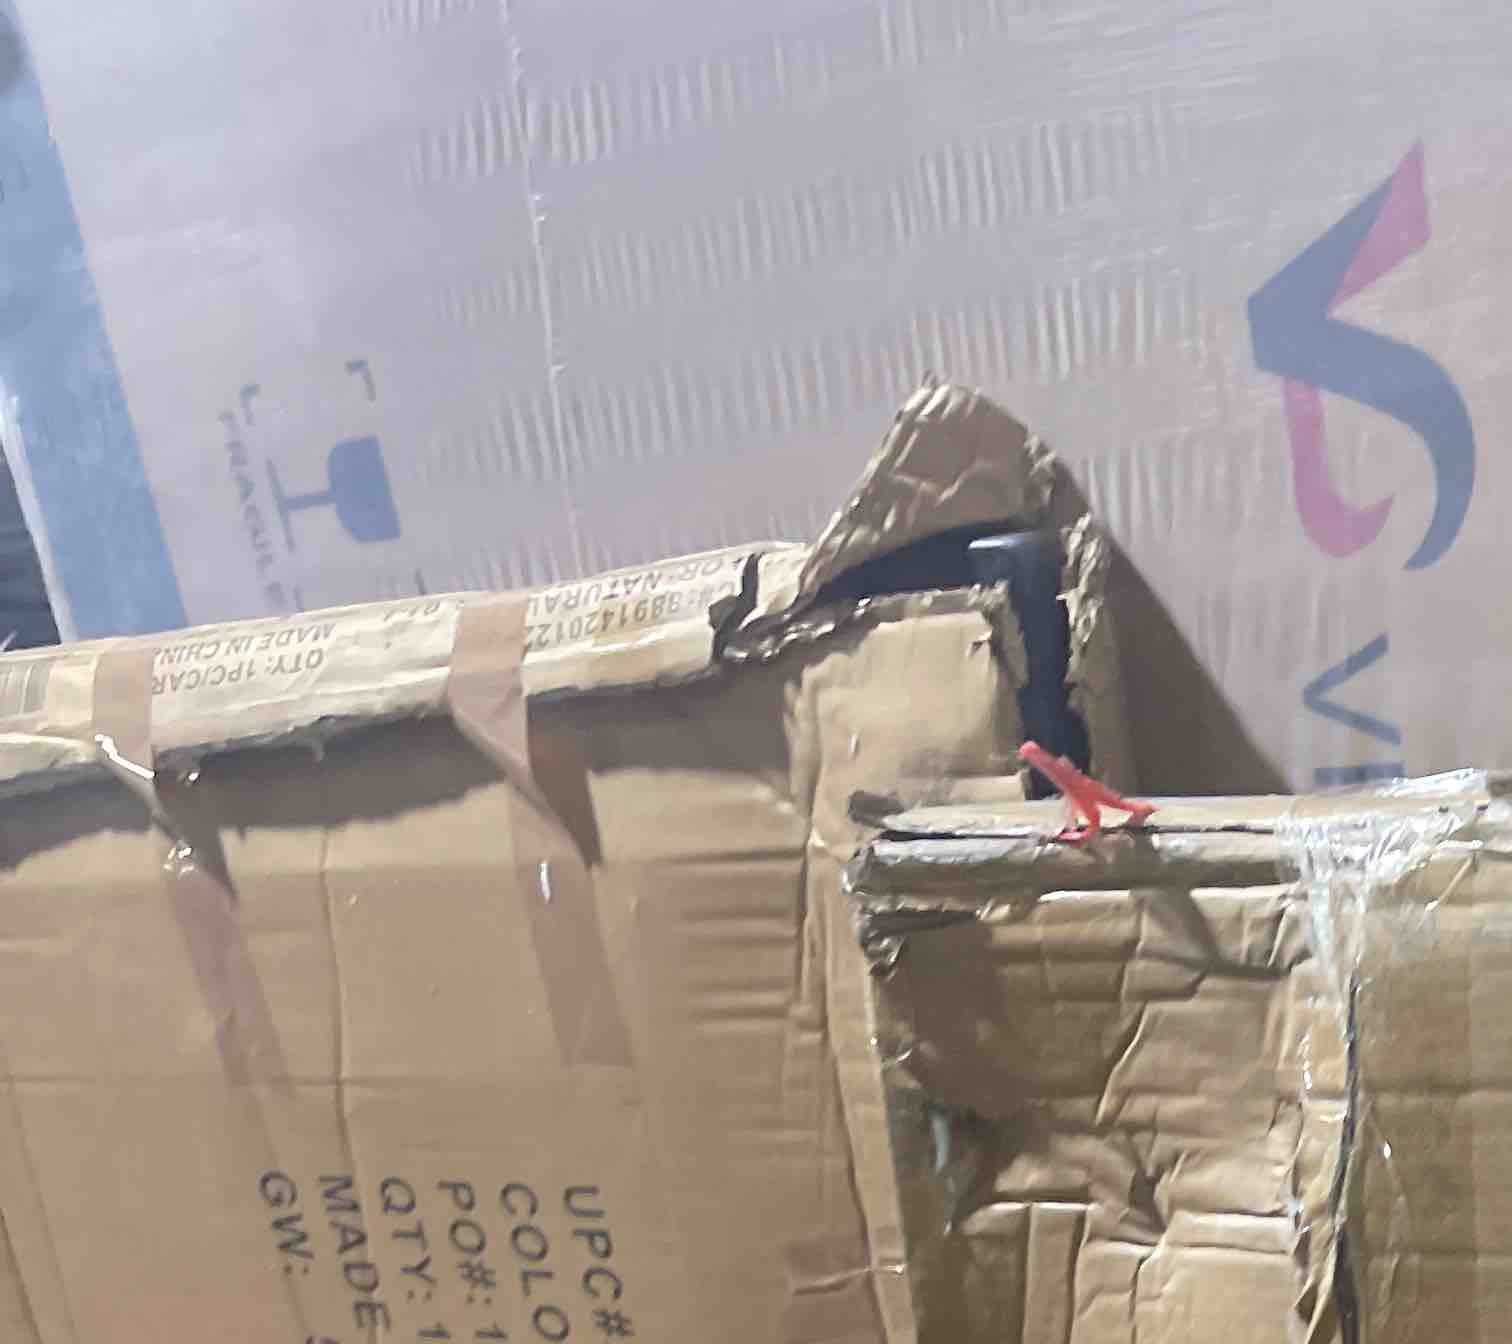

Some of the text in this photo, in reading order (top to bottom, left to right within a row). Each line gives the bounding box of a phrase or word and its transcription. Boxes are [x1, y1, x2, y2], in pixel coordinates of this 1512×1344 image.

[260, 623, 336, 645] MADE
[266, 649, 325, 677] QTY:
[258, 1171, 315, 1277] GW:
[318, 1174, 392, 1331] MADE
[380, 1177, 437, 1302] QTY:
[437, 1180, 497, 1305] PO#:
